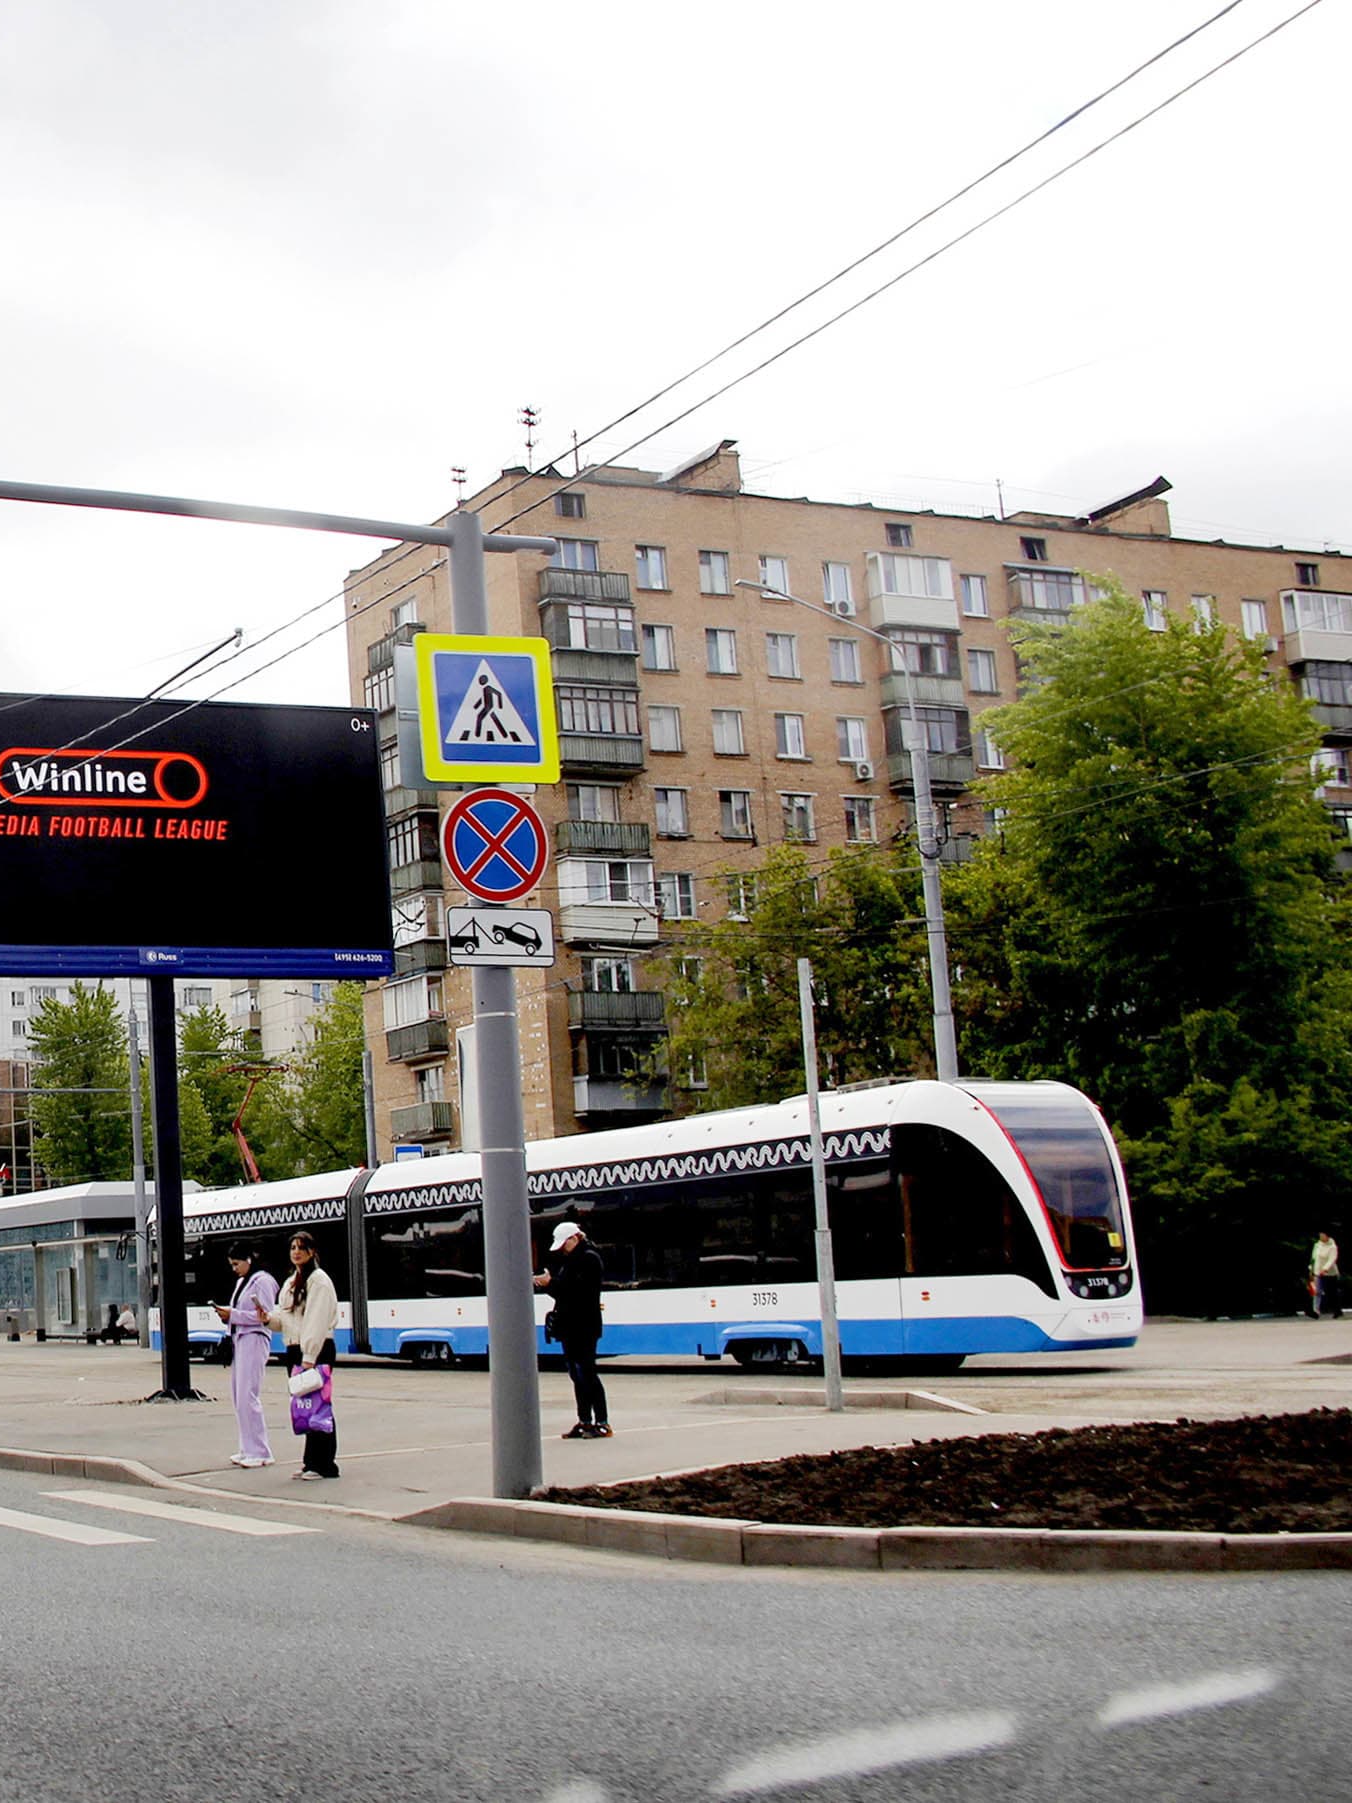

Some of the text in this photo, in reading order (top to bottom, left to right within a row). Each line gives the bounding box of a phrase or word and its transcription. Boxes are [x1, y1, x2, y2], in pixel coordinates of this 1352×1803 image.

[350, 717, 370, 732] 0+
[11, 760, 148, 794] Winline
[48, 815, 146, 839] FOOTBALL
[154, 818, 230, 841] LEAGUE
[158, 952, 177, 961] Russ
[752, 1291, 778, 1306] 31378
